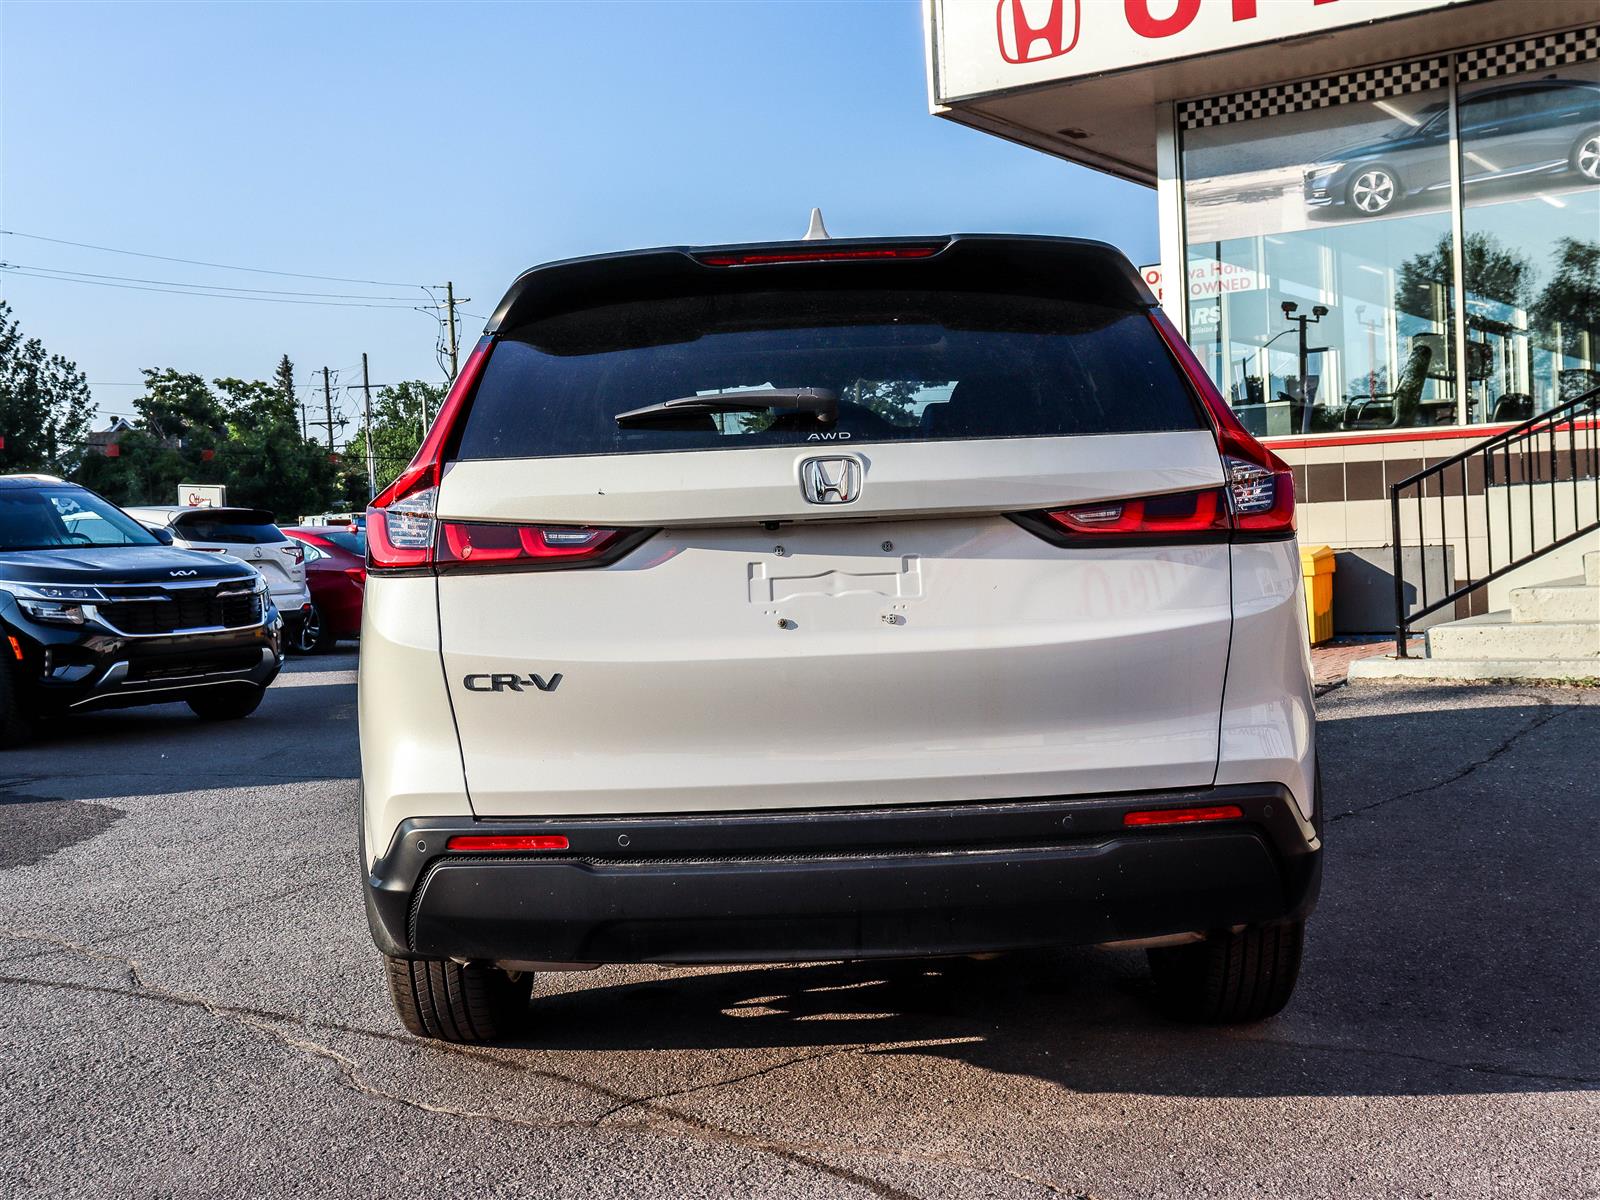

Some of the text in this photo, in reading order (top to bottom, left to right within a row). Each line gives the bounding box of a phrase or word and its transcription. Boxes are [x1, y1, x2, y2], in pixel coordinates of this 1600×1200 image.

[1190, 277, 1252, 296] OWNED
[807, 432, 851, 441] AWD
[463, 672, 564, 692] CR-V
